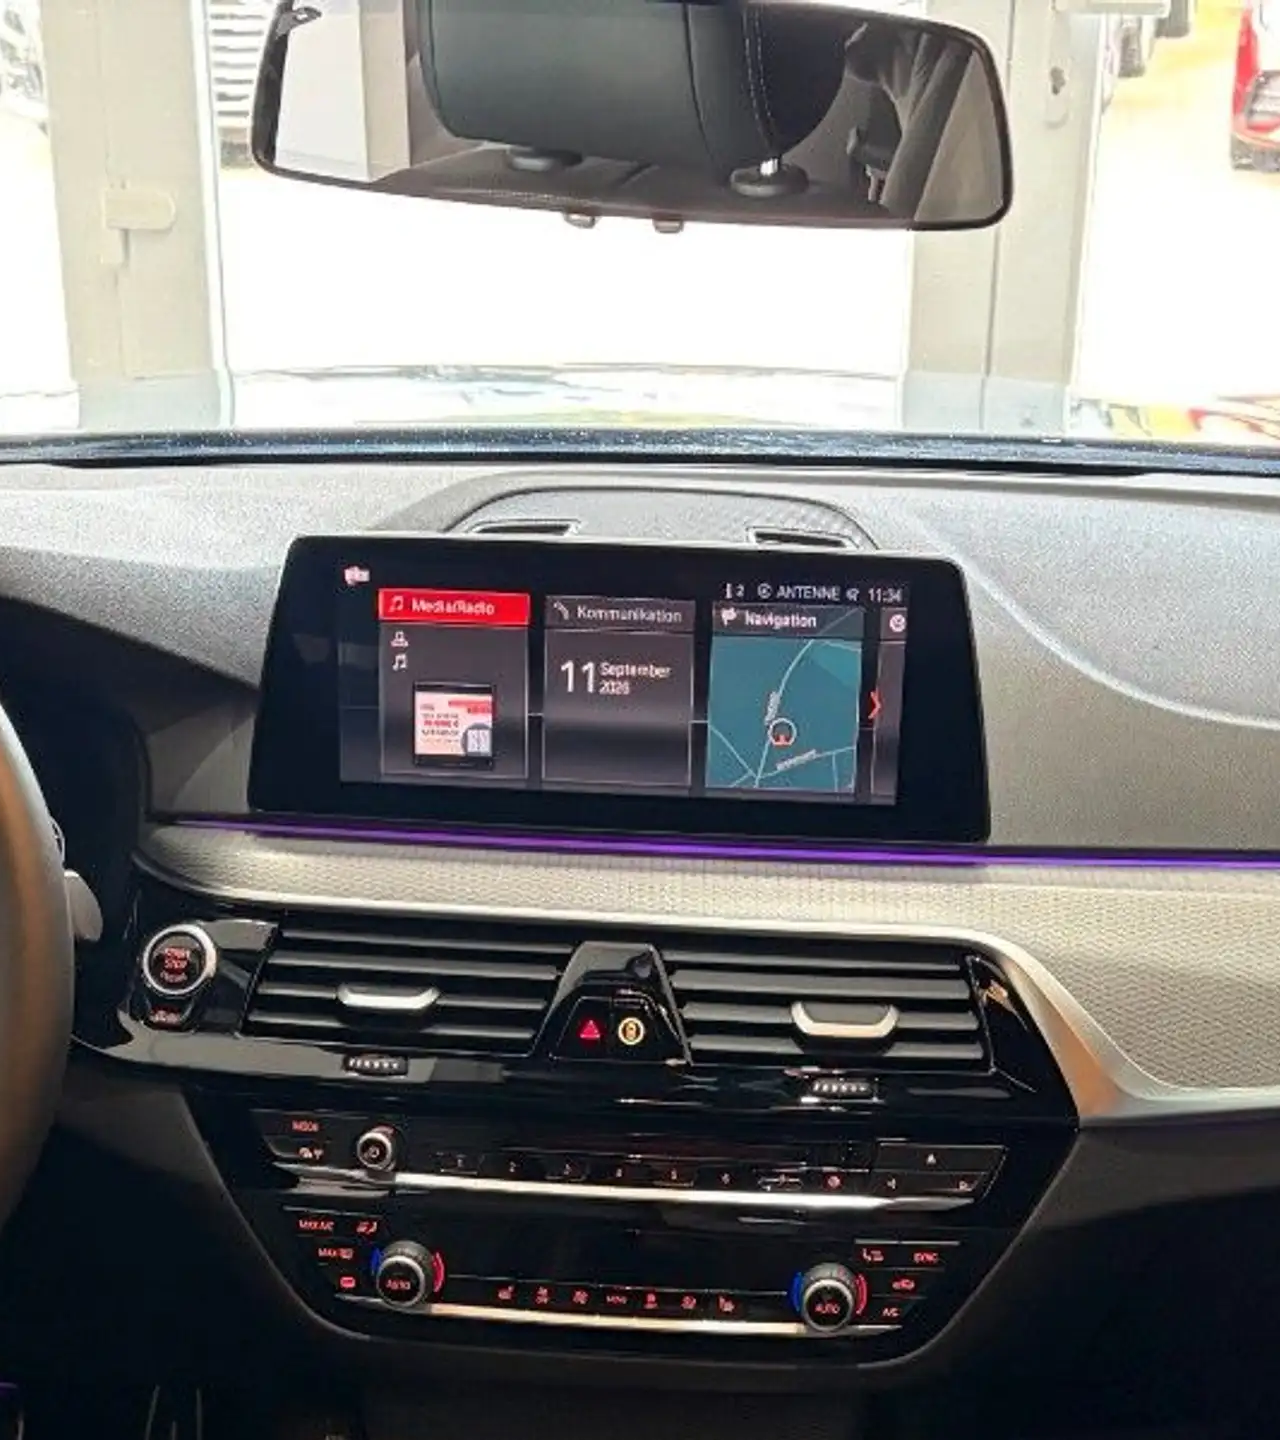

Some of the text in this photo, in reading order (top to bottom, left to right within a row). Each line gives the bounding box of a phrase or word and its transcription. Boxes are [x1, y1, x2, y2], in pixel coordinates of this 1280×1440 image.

[776, 585, 841, 601] ANTENNE
[868, 588, 903, 602] 11:34
[411, 599, 495, 616] Media/Radio
[577, 605, 683, 623] Kommunikation
[744, 609, 817, 629] Navigation
[561, 660, 672, 693] 11 September
